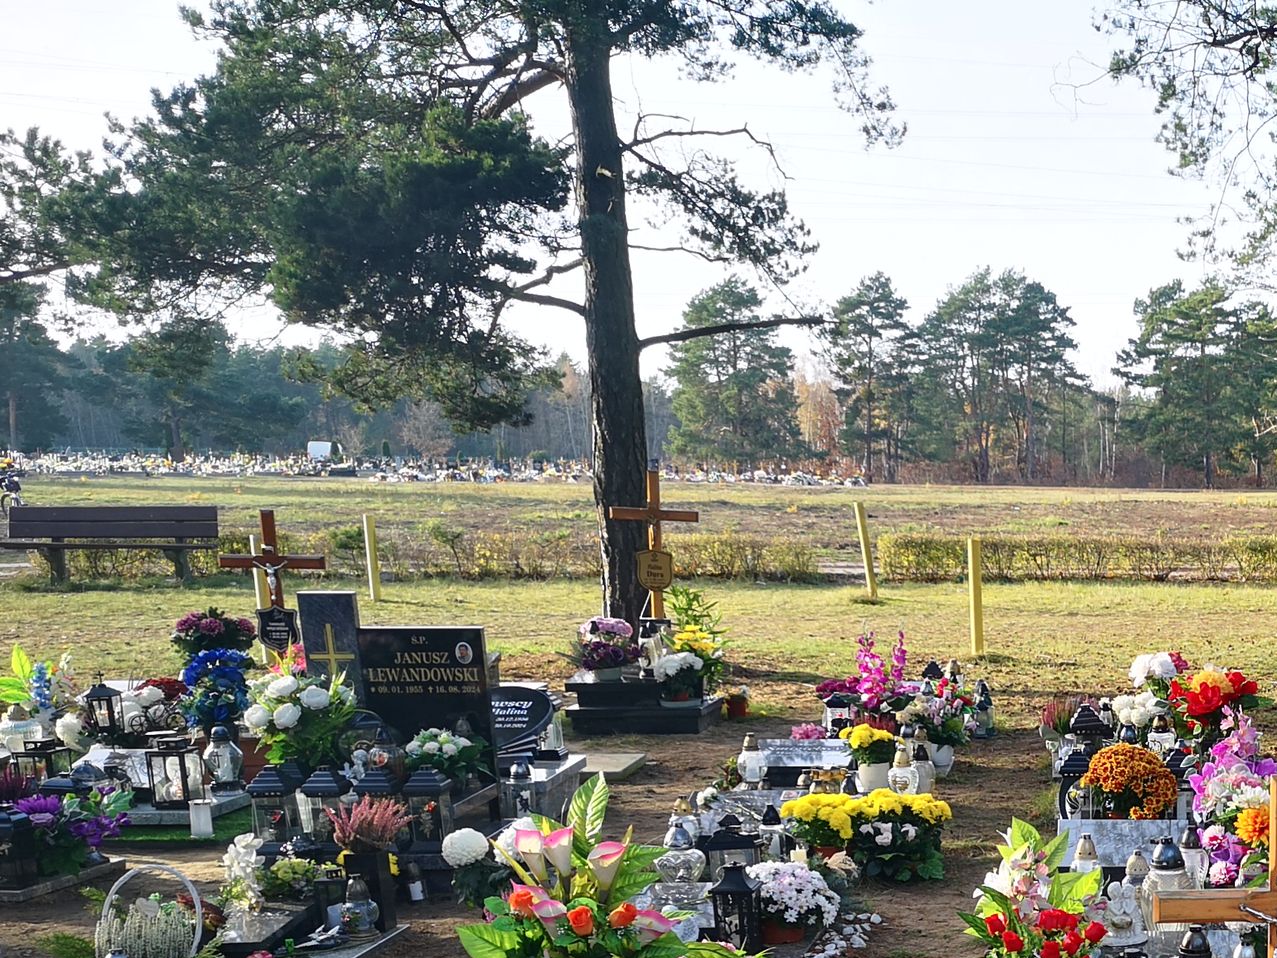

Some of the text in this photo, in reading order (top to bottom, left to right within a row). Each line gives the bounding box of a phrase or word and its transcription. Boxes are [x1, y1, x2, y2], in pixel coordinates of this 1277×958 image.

[394, 651, 450, 664] JANUSZ
[367, 667, 480, 682] LEWANDOWSKI
[491, 701, 533, 709] wscy
